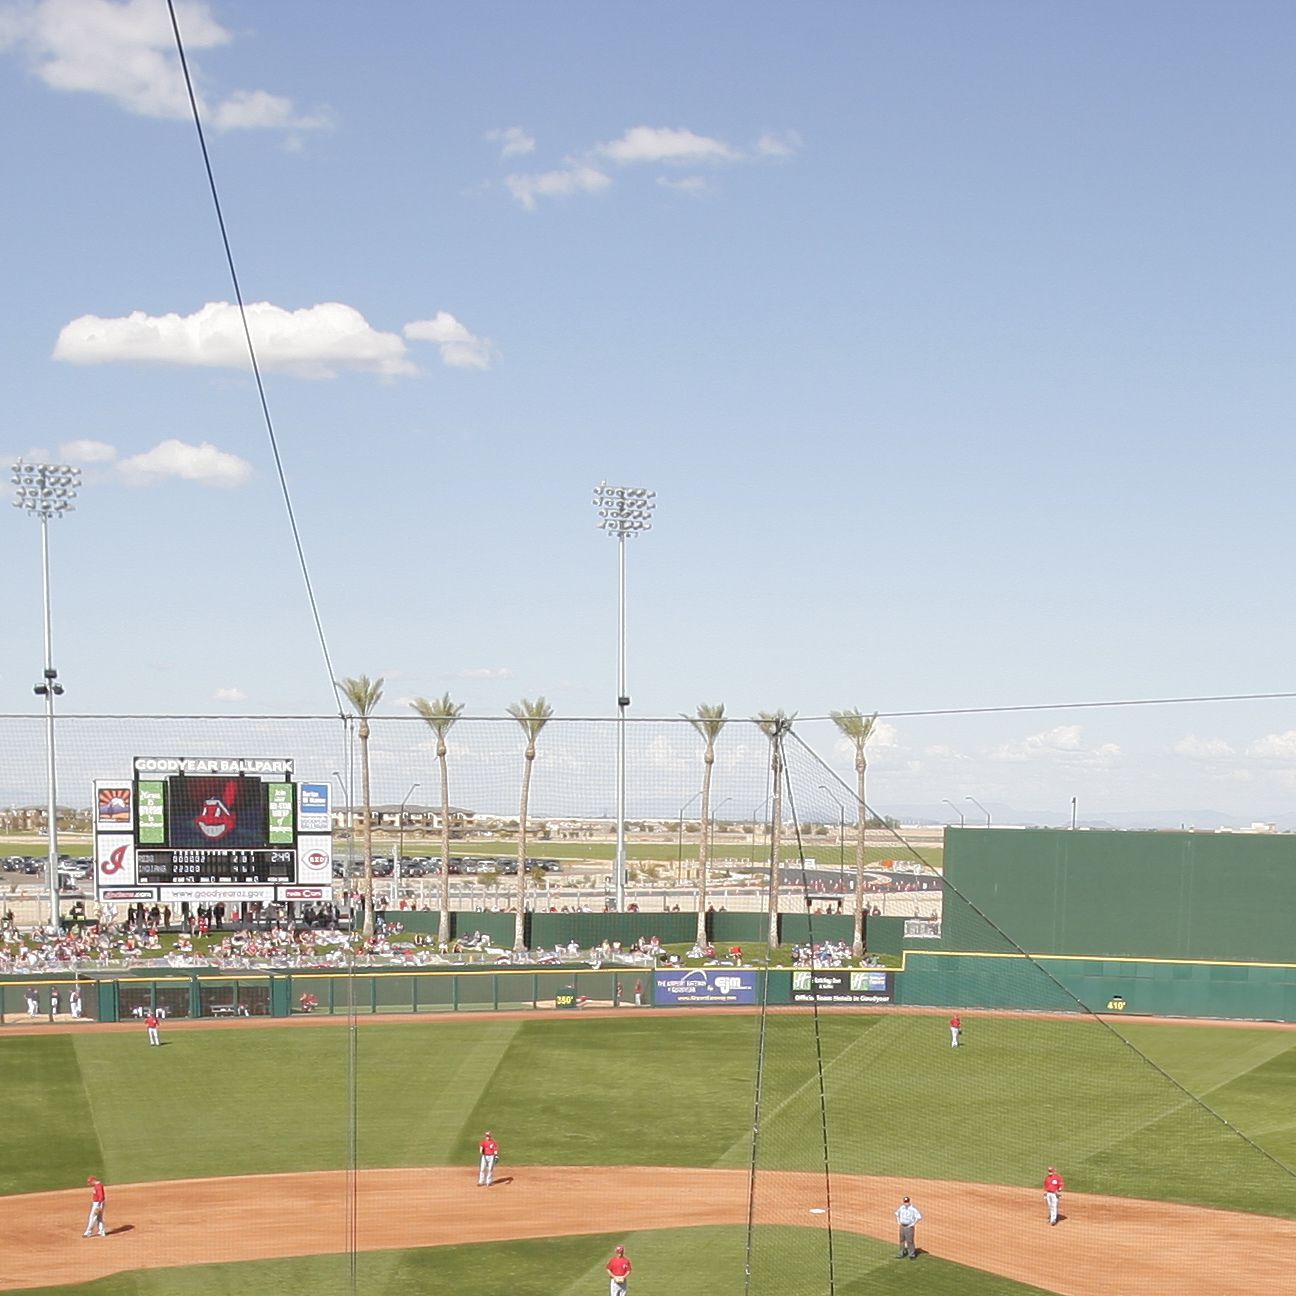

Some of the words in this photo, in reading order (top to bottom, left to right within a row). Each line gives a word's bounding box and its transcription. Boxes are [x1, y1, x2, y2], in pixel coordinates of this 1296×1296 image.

[134, 759, 218, 771] GOODYEAR
[220, 760, 293, 772] BALLPARK
[1106, 1001, 1126, 1010] 410'
